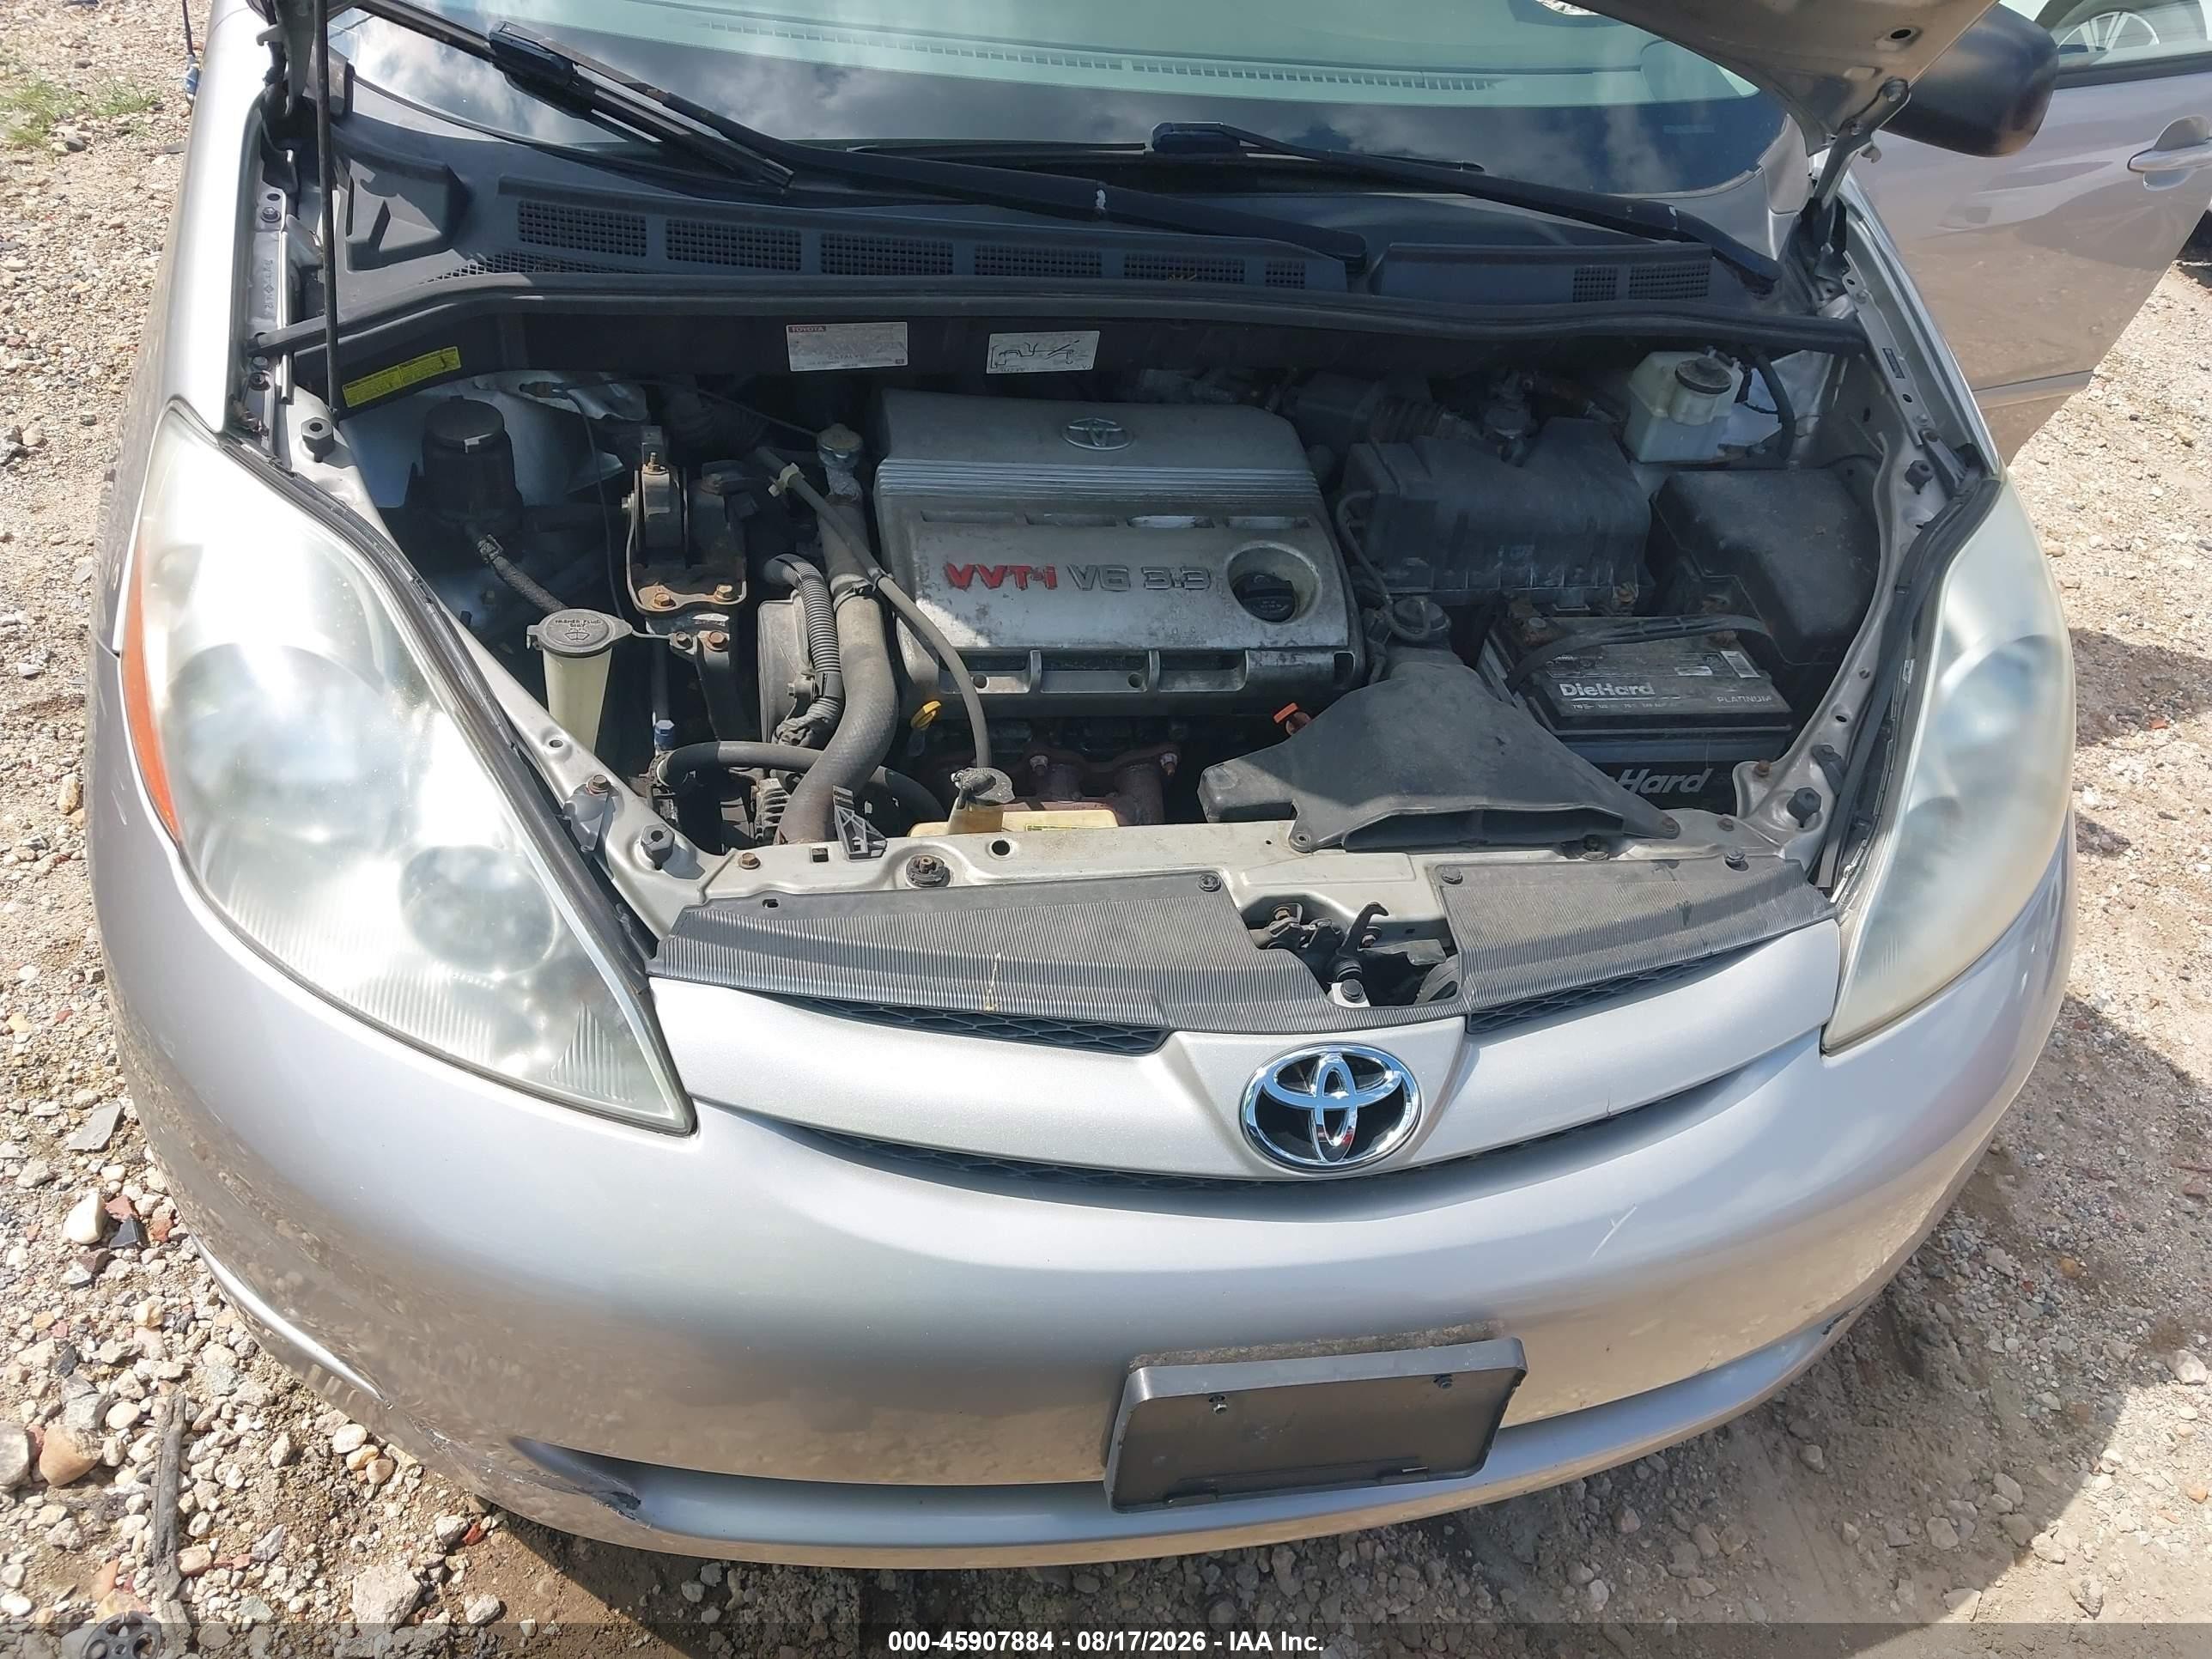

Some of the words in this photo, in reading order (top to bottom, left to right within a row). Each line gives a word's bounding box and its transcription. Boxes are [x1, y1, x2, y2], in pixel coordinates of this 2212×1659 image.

[1067, 563, 1131, 592] V6
[1141, 565, 1212, 591] 3.3
[1559, 682, 1656, 696] DieHard
[1717, 695, 1771, 703] PLATINUM
[1608, 768, 1714, 793] Hard
